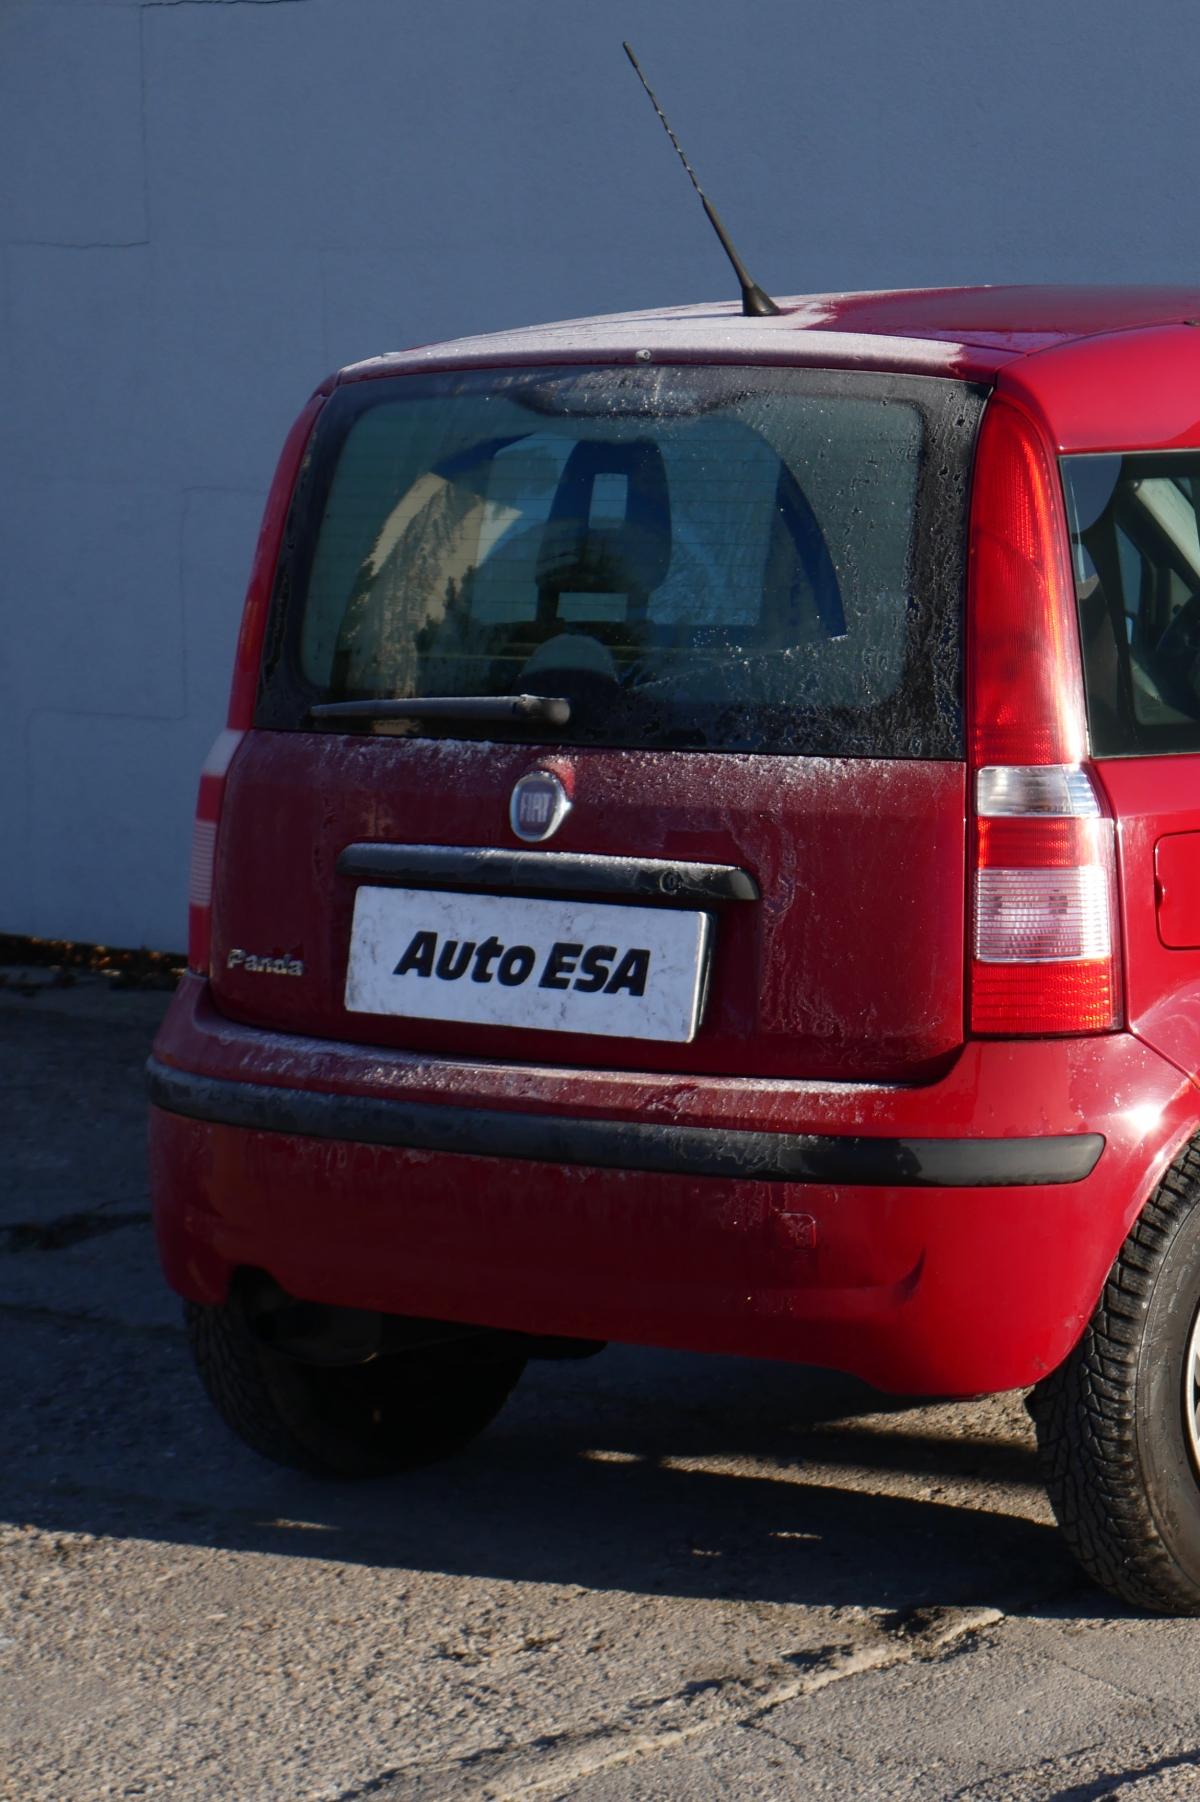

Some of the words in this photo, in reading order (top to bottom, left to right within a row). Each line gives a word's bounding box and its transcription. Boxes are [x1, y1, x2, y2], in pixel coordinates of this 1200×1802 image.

[226, 948, 304, 976] Panda
[392, 930, 536, 987] Auto
[538, 942, 651, 997] ESA
